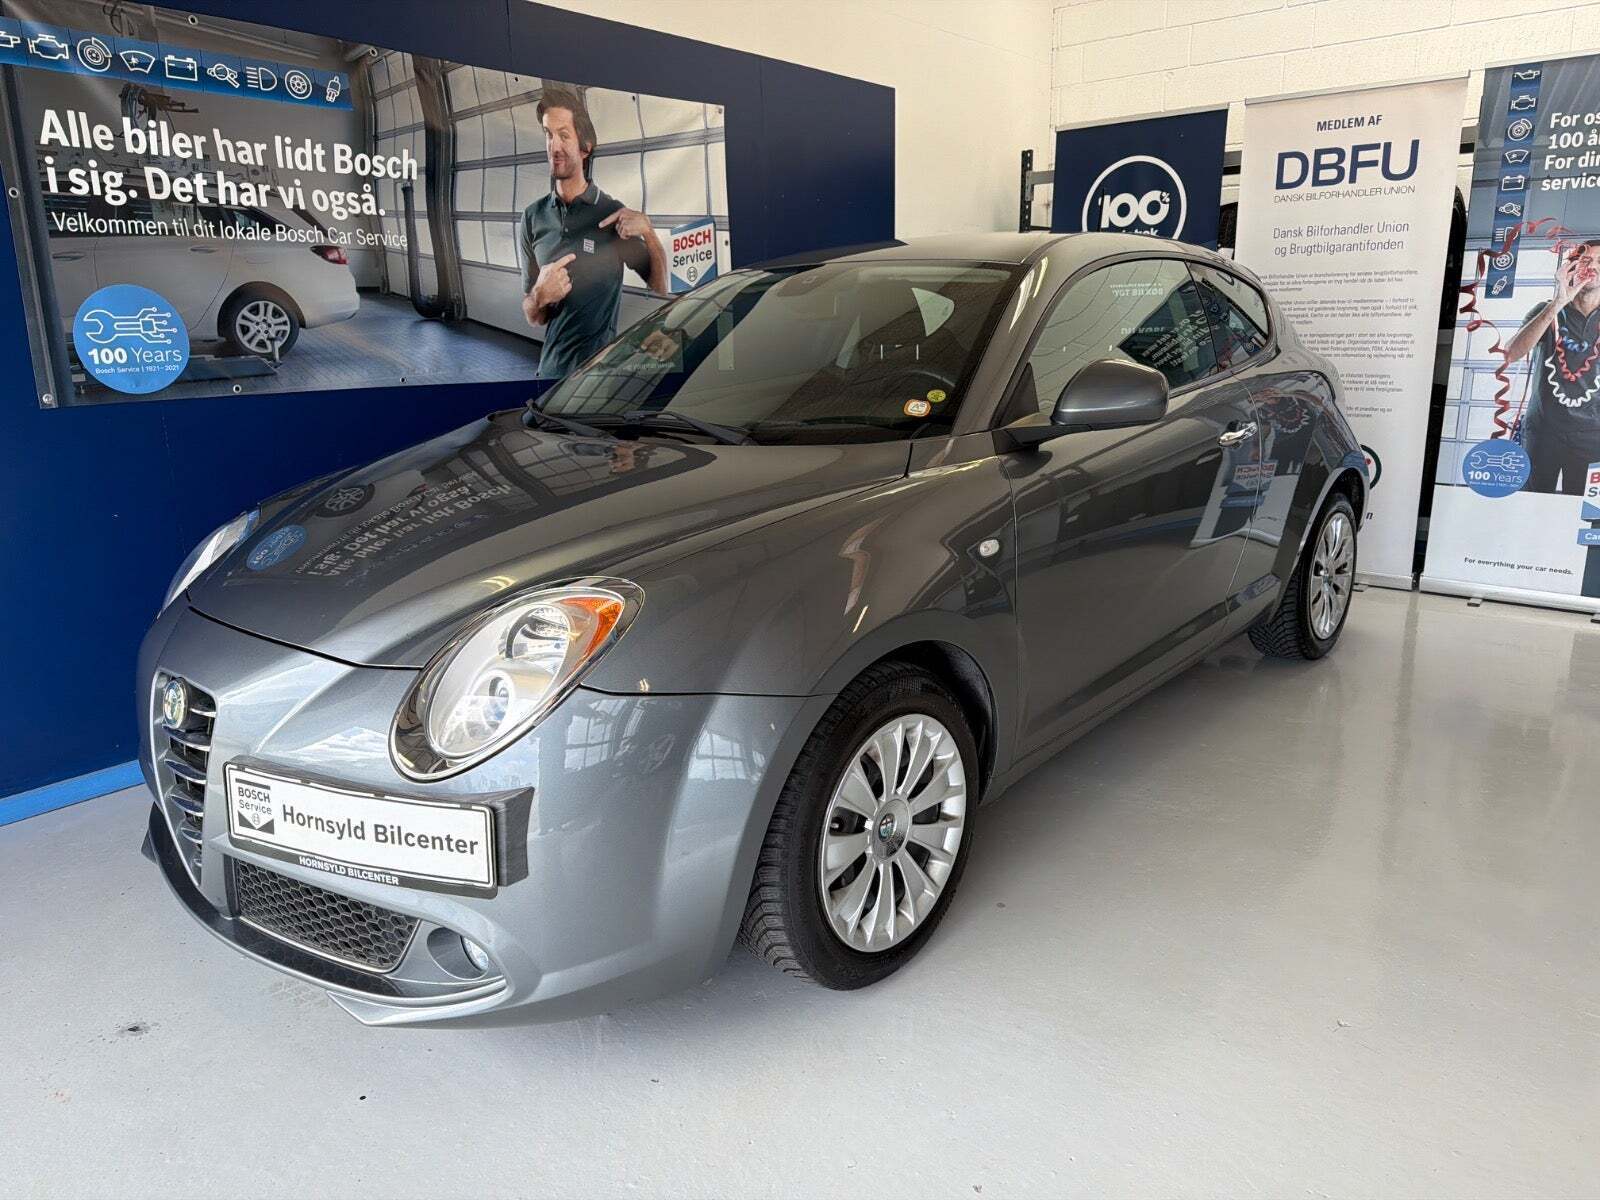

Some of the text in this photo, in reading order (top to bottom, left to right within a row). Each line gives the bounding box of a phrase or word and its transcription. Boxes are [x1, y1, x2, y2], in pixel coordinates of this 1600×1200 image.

[1316, 114, 1383, 132] MEDLEM AF
[1550, 112, 1580, 129] For
[40, 109, 418, 180] Alle biler har lidt Bosch
[1548, 131, 1584, 149] 100
[1275, 139, 1420, 190] DBFU
[1544, 155, 1575, 170] For
[44, 156, 386, 221] i sig. Det har vi også.
[1274, 185, 1416, 203] DANSK BILFORHANDLER UNION
[51, 211, 408, 247] Velkommen til dit lokale Bosch Car Service
[1273, 221, 1410, 239] Dansk Bilforhandler Union
[673, 229, 711, 252] BOSCH
[1274, 239, 1404, 257] og Brugtbilgarantifonden
[672, 249, 713, 267] Service
[88, 346, 182, 364] 100 Years
[1468, 471, 1522, 483] 100 Years
[1478, 559, 1515, 570] everything
[238, 787, 271, 803] BOSCH
[239, 799, 273, 815] Service
[282, 804, 479, 855] Hornsyld Bilcenter
[299, 856, 400, 886] HORNSYLD BILCENTER
